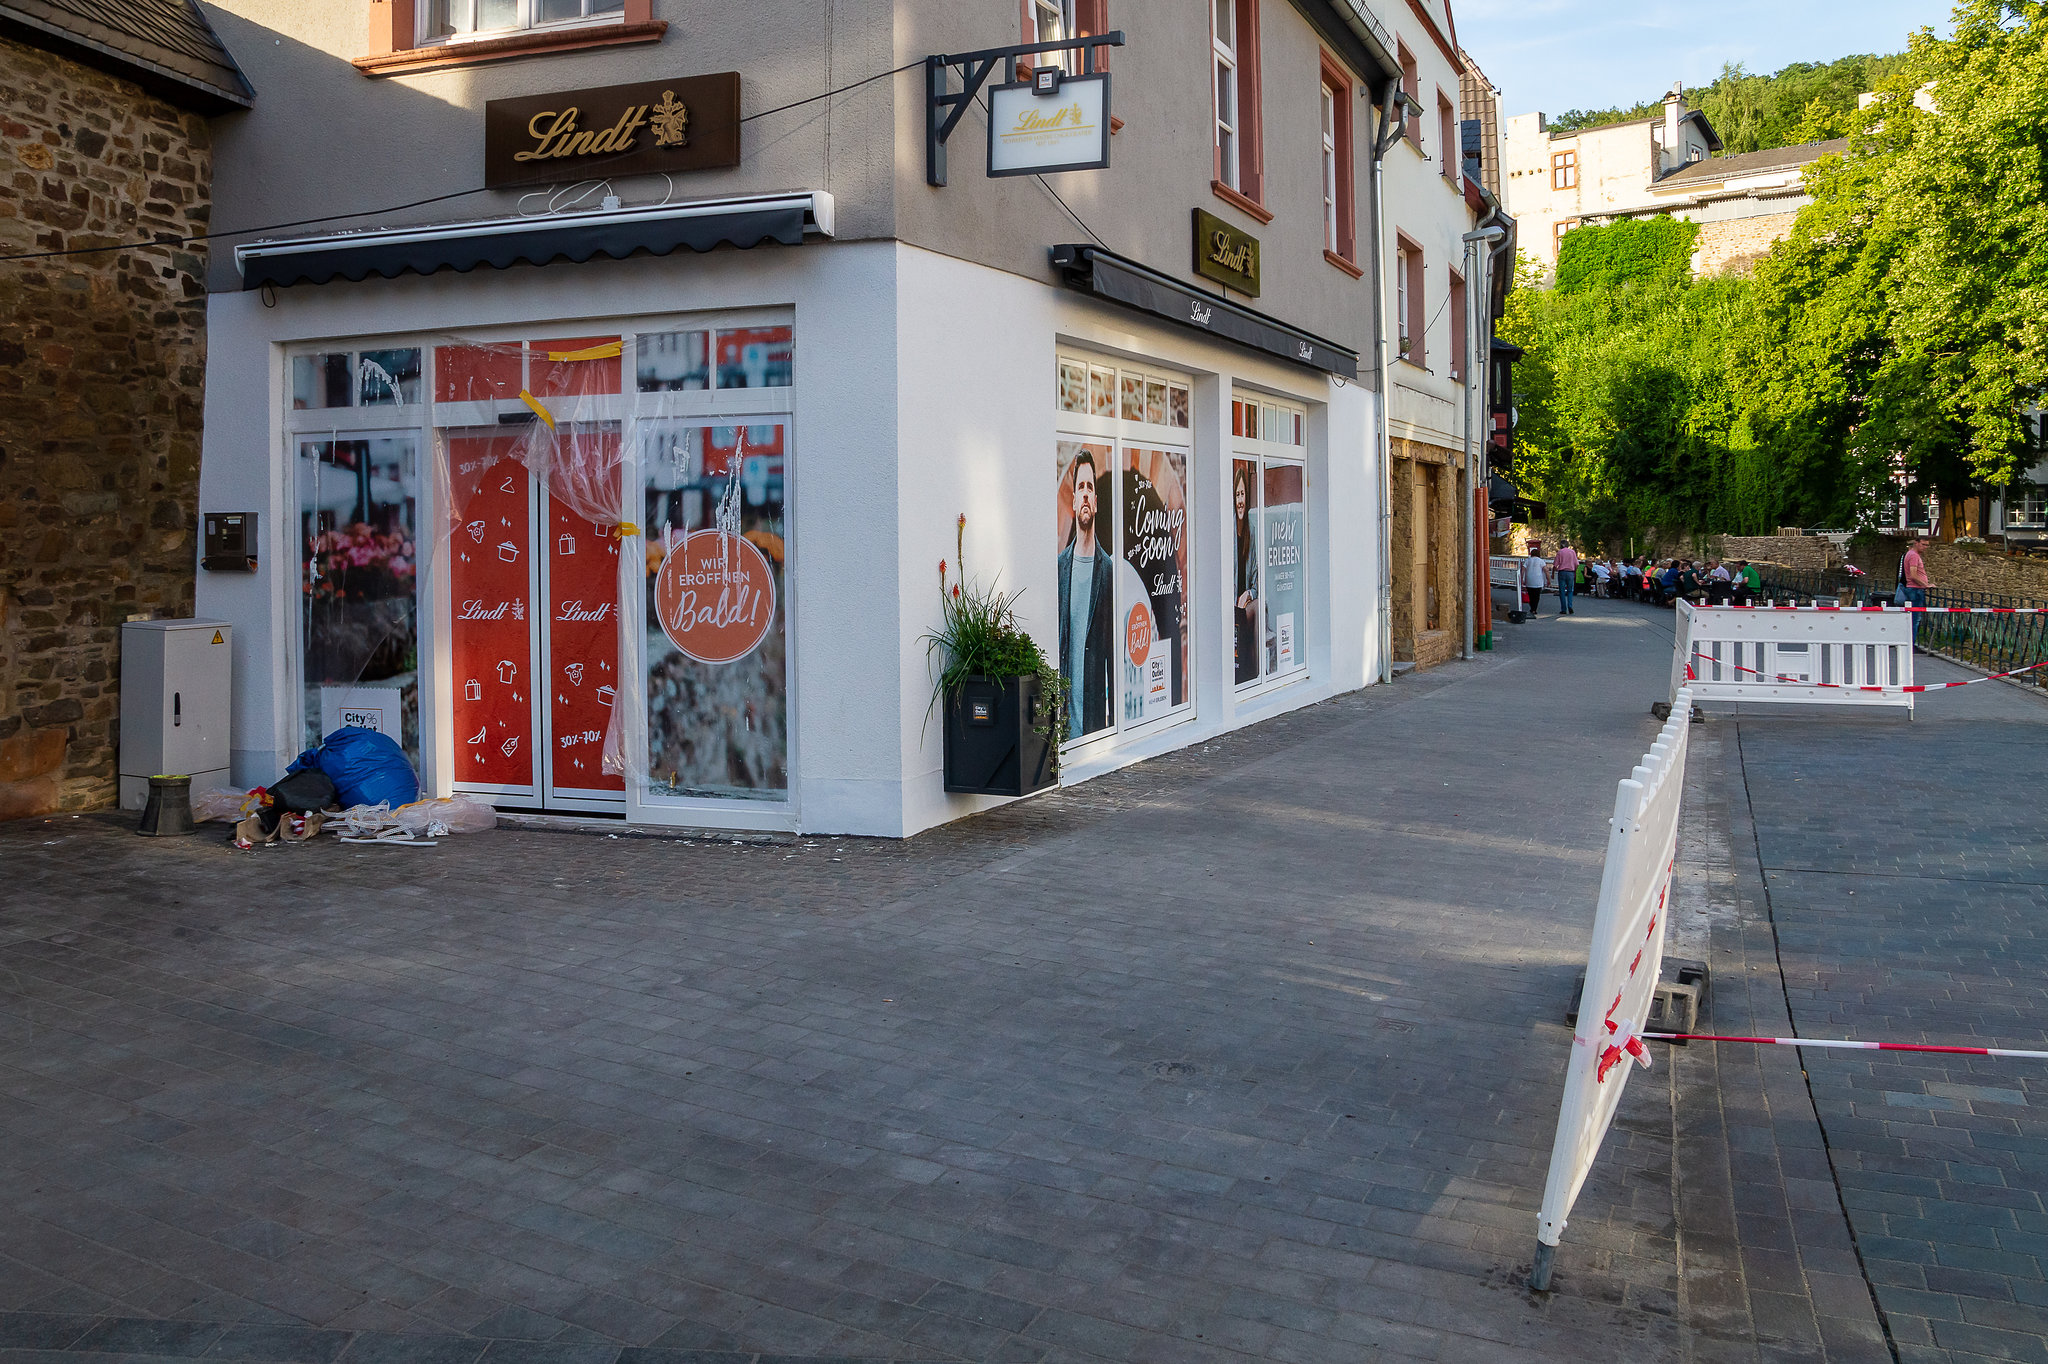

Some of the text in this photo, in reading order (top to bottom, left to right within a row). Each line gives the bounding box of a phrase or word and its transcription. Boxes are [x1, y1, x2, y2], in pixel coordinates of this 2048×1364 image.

[1012, 108, 1068, 131] Lindt
[514, 105, 649, 162] Lindt
[1213, 230, 1247, 273] Lindt
[1190, 301, 1212, 325] Lindt
[1299, 341, 1313, 361] Lindt
[1135, 494, 1185, 551] Coming
[1140, 536, 1174, 568] soon
[1268, 546, 1301, 567] ERLEBEN
[700, 558, 727, 570] WIR
[679, 570, 750, 586] ERÖFFNEN
[1151, 573, 1176, 597] Lindt
[457, 599, 509, 620] Lindt
[555, 600, 611, 622] Lindt
[671, 584, 761, 633] Bald!
[344, 712, 366, 725] City
[560, 730, 602, 749] 30%-70%
